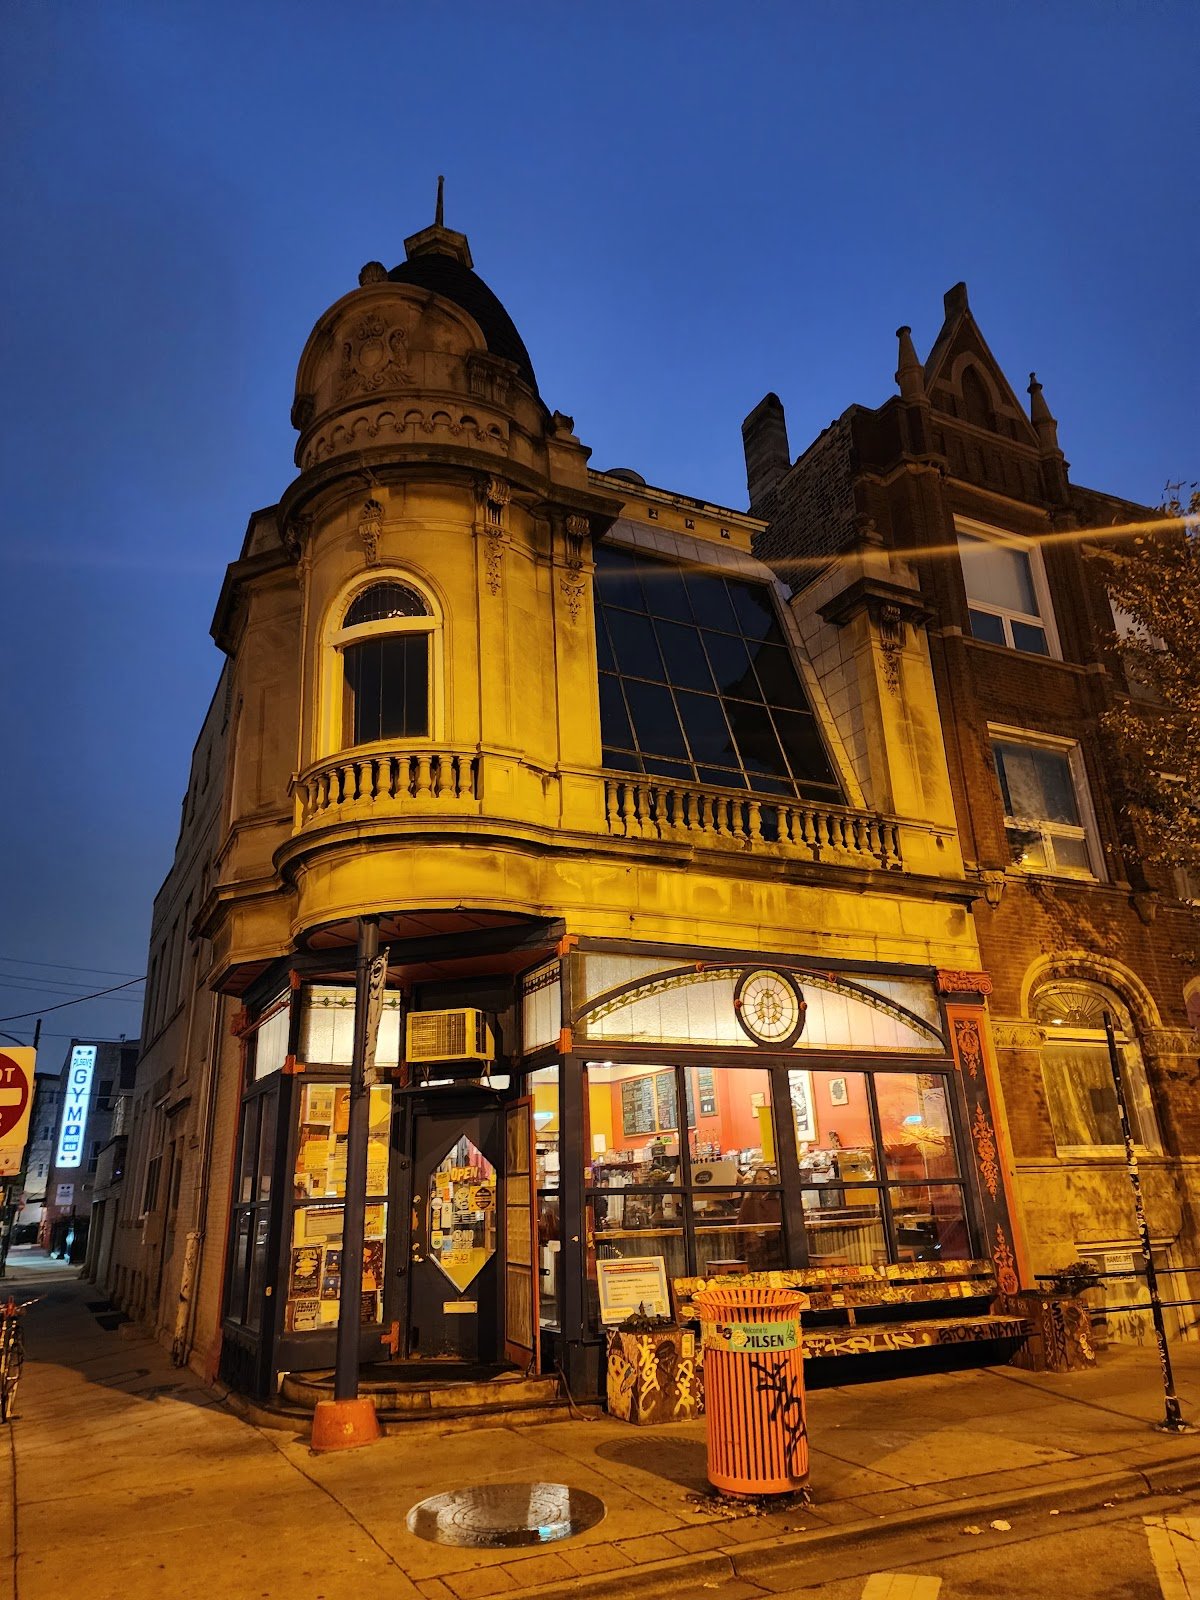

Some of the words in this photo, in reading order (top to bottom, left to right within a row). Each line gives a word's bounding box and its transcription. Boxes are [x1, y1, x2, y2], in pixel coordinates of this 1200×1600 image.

[67, 1069, 88, 1121] GYM
[451, 1167, 478, 1181] OPEN
[743, 1326, 762, 1334] Welcome
